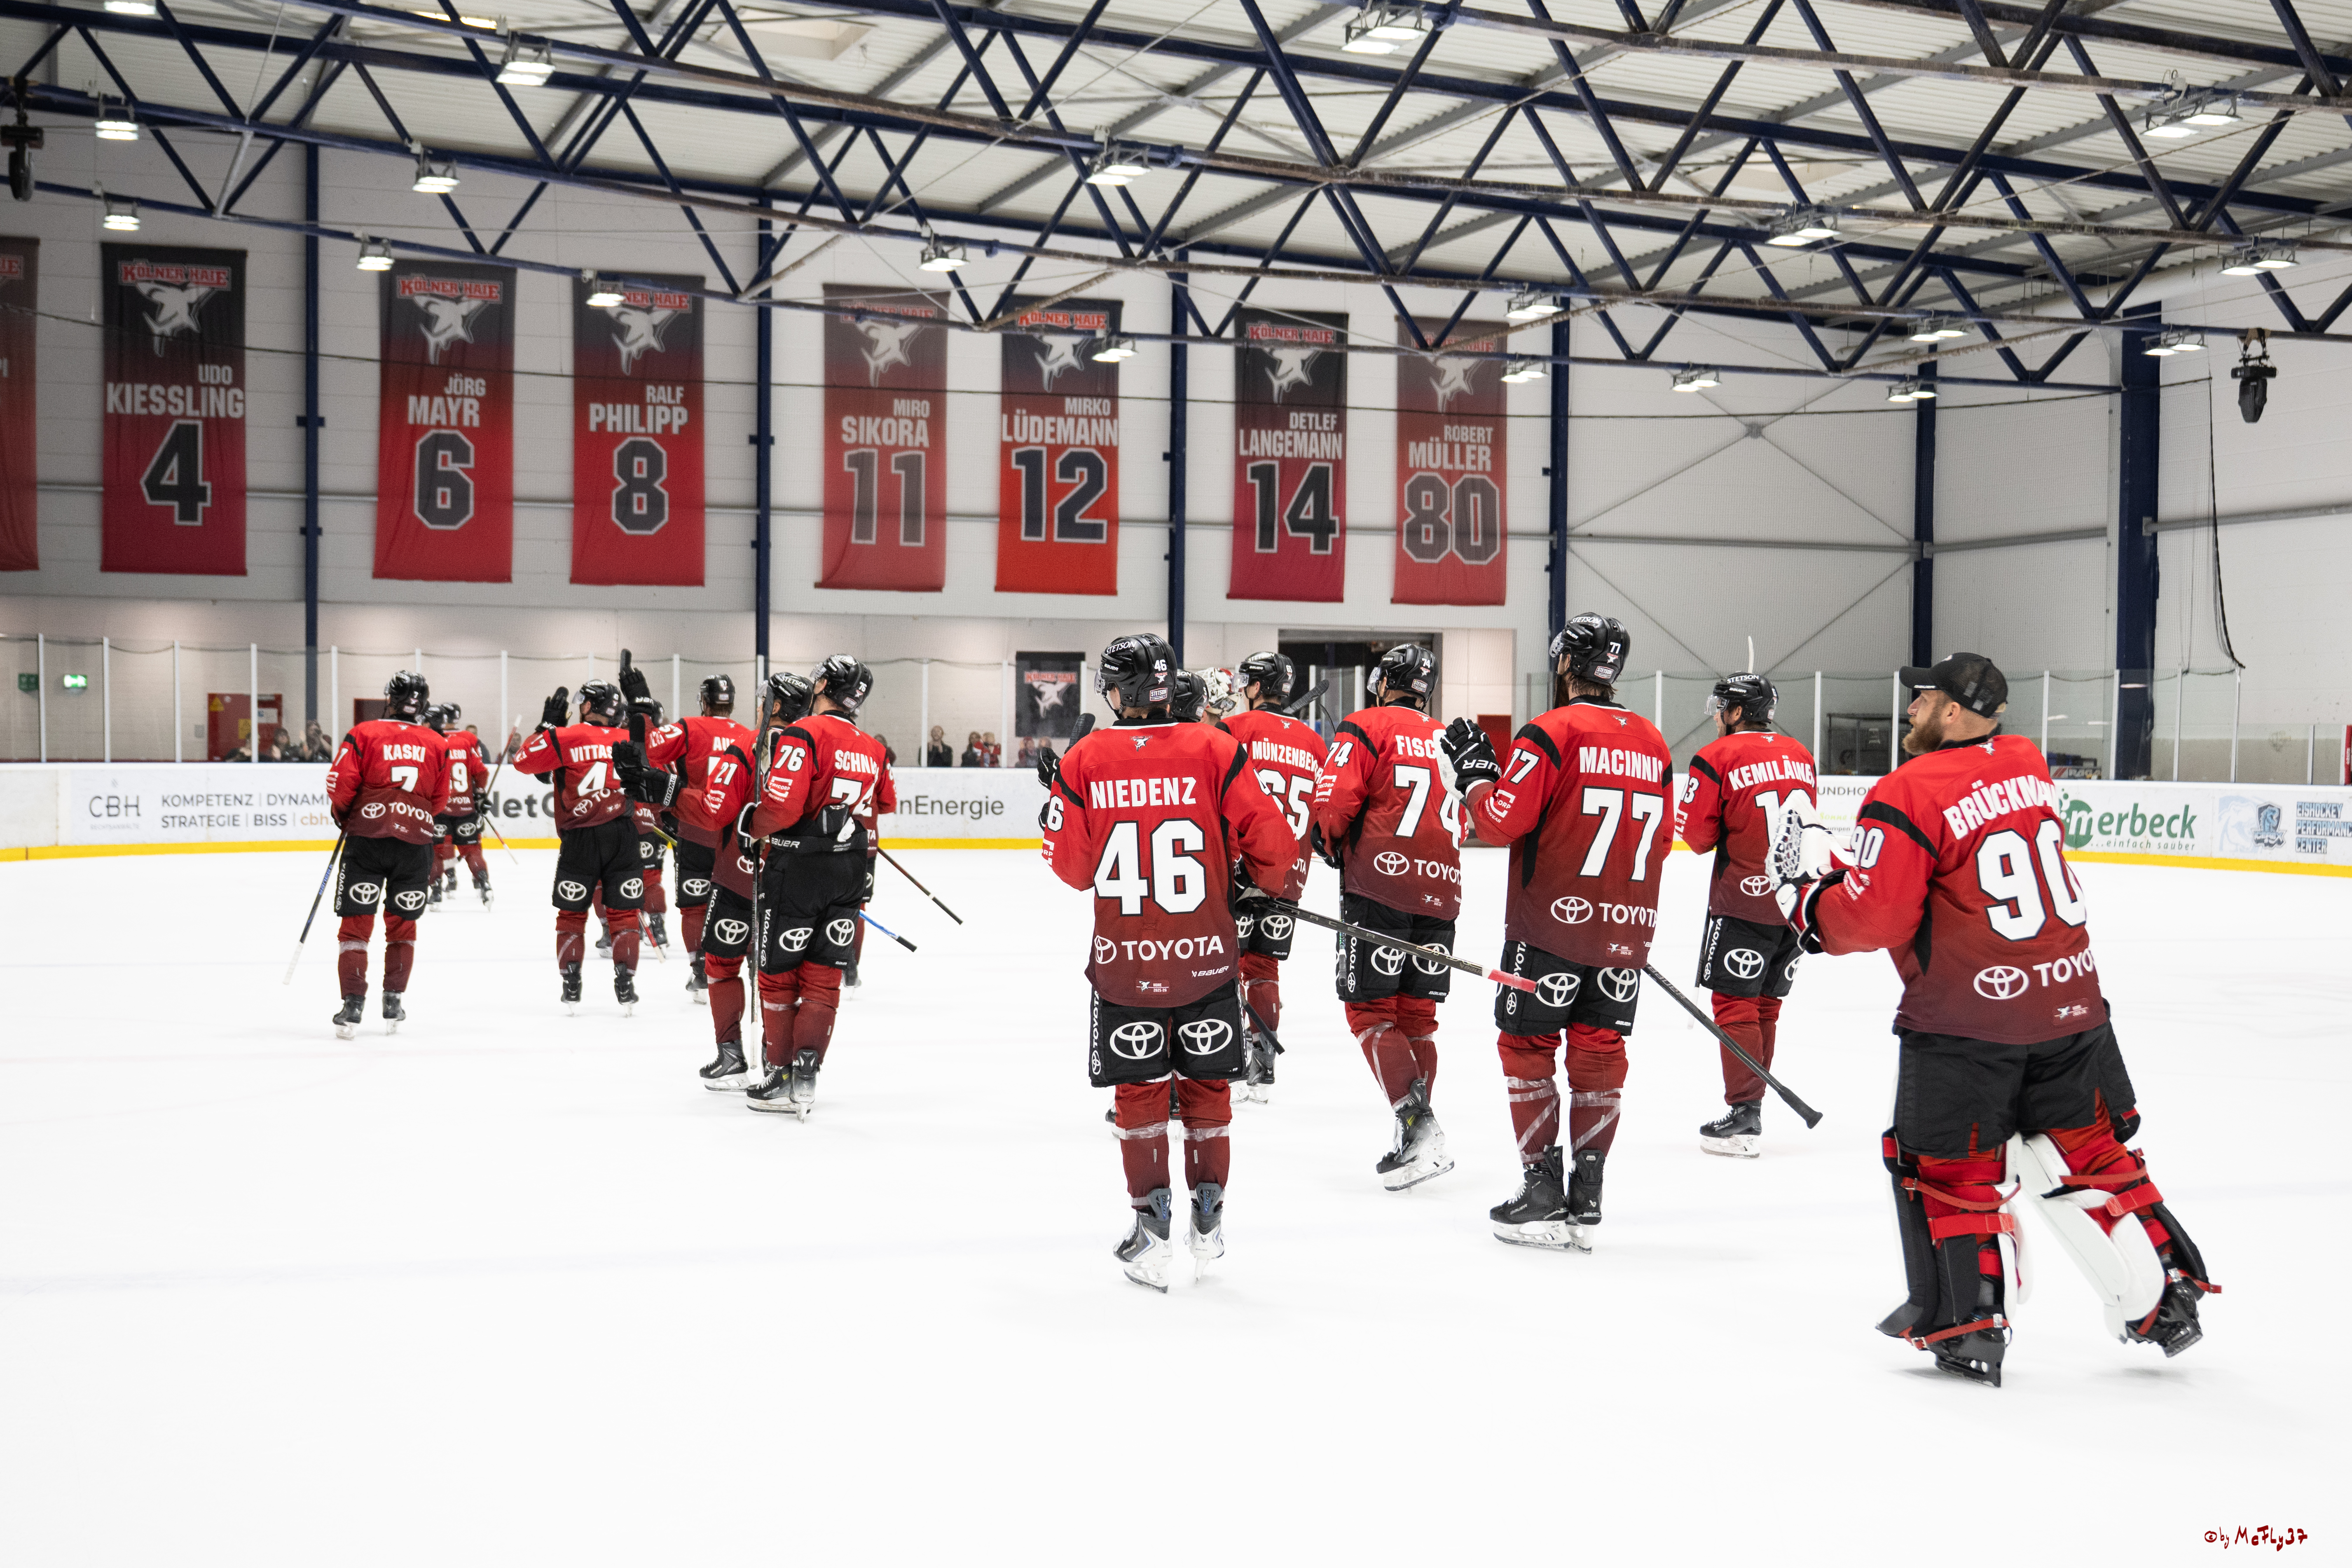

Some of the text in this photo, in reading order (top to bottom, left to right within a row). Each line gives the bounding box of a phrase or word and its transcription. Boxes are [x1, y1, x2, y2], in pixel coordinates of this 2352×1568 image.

[121, 260, 229, 288] KÖLNER HAIE
[400, 276, 500, 301] KÖLNER HAIE
[654, 293, 689, 309] HAIE
[1074, 314, 1106, 329] HAIE
[1303, 328, 1333, 343] HAIE
[198, 364, 233, 385] UDO
[445, 374, 486, 397] JÖRG
[106, 382, 245, 419] KIESSLING
[646, 386, 685, 403] RALF
[1065, 397, 1111, 416] MIRKO
[408, 395, 480, 428] MAYR
[590, 403, 689, 434] PHILIPP
[894, 399, 930, 417] MIRO
[842, 416, 929, 448] SIKORA
[1002, 410, 1119, 447] LÜDEMANN
[1289, 412, 1337, 431] DETLEF
[1239, 429, 1343, 460] LANGEMANN
[1444, 425, 1494, 444] ROBERT
[1409, 436, 1491, 472] MÜLLER
[139, 419, 212, 526] 4
[414, 429, 475, 530] 6
[612, 437, 669, 535] 8
[844, 448, 925, 547] 11
[1012, 446, 1108, 544] 12
[1247, 460, 1339, 555] 14
[1403, 472, 1500, 565] 80
[1566, 630, 1578, 639] BAUER
[1105, 641, 1137, 656] STETSON
[1610, 641, 1621, 654] 77
[1154, 659, 1168, 671] 46
[1421, 658, 1431, 668] 74
[1597, 667, 1613, 675] STETSON
[782, 676, 808, 690] STETSON
[858, 681, 867, 692] 76
[1413, 680, 1427, 689] STETSON
[1727, 674, 1759, 684] STETSON
[1151, 688, 1167, 697] STETSON
[383, 744, 426, 763] KASKI
[449, 749, 467, 760] LEOD
[569, 744, 613, 763] VITTAS
[774, 744, 806, 772] 76
[1324, 741, 1355, 768] 74
[1395, 735, 1437, 759] FISC
[714, 762, 738, 786] 21
[834, 749, 879, 776] SCHN
[391, 765, 419, 793] 7
[577, 761, 621, 797] 4
[664, 773, 677, 806] ERWOOD
[769, 782, 791, 791] TRICORP
[161, 793, 330, 807] KOMPETENZ DYNAMI
[1090, 777, 1196, 809] NIEDENZ
[89, 795, 141, 818] CBH
[388, 802, 434, 825] TOYOTA
[893, 795, 1005, 820] nEnergie
[1046, 795, 1064, 832] 6
[1393, 764, 1462, 851] 74
[1485, 798, 1502, 823] WORKWEAR
[2296, 802, 2343, 819] EISHOCKEY
[161, 814, 240, 828] STRATEGIE
[254, 814, 288, 826] BISS
[2067, 803, 2198, 840] merbeck
[2296, 819, 2352, 838] PERFORMANC
[771, 837, 800, 849] BAUER
[1581, 786, 1663, 882] 77
[2157, 840, 2195, 852] sauber
[2295, 837, 2328, 854] CENTER
[1850, 824, 1886, 870] 90
[1093, 817, 1206, 917] 46
[1976, 818, 2087, 942] 90
[705, 889, 718, 925] TOYOTA
[1598, 903, 1658, 928] TOYOTA
[762, 908, 772, 949] TOYOTA
[1707, 917, 1723, 962] TOYOTA
[1121, 935, 1224, 961] TOYOTA
[1349, 921, 1359, 971] TOYOA
[1197, 966, 1229, 977] BAUER
[2032, 948, 2094, 987] TOYO
[1648, 964, 1687, 999] BAUER
